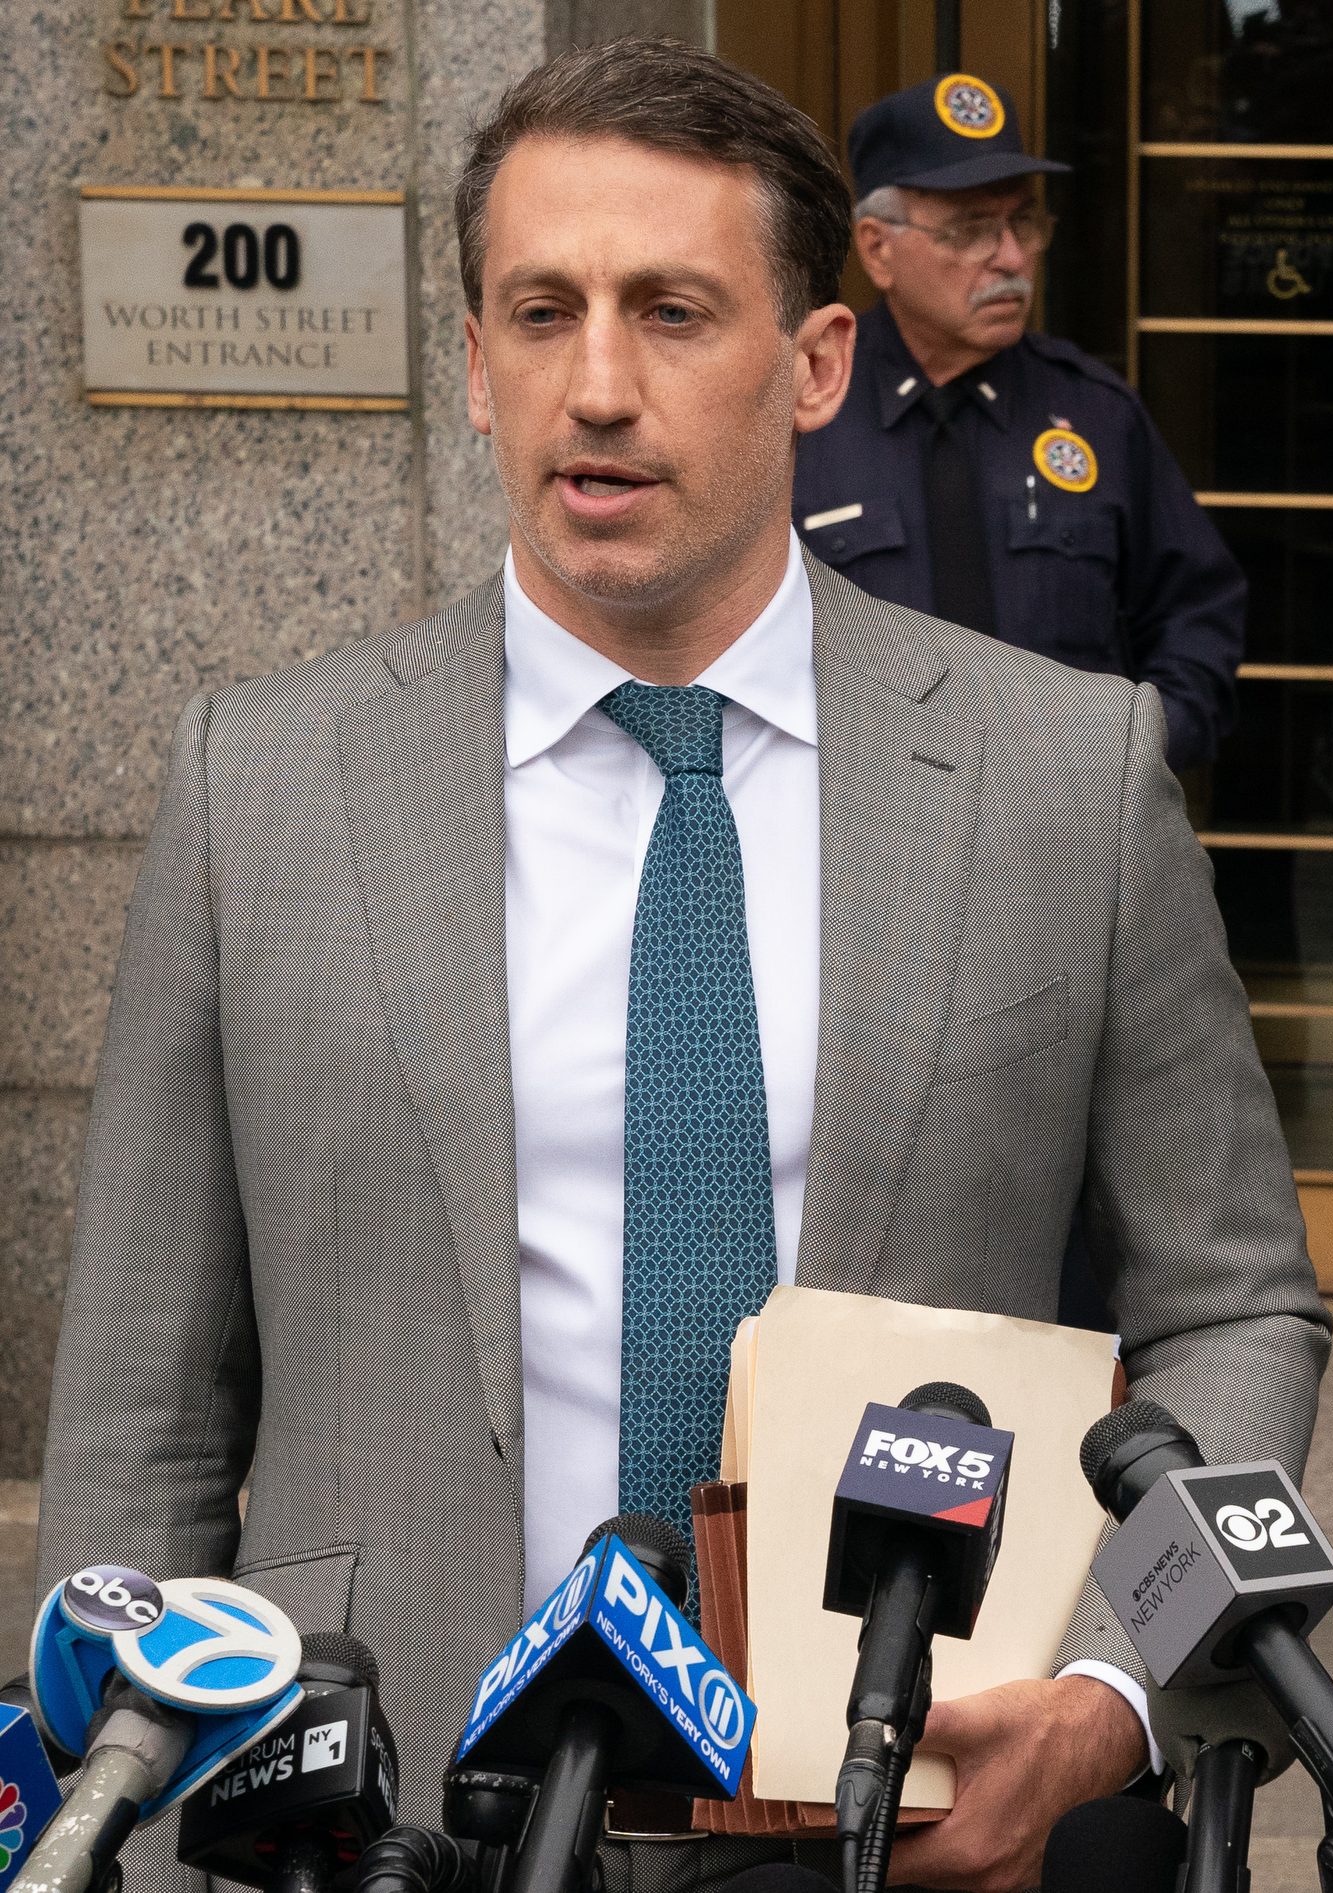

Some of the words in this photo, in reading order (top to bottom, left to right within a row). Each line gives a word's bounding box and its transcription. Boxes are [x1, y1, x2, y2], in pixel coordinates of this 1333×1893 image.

[104, 42, 392, 103] STREET
[182, 222, 301, 291] 200
[104, 303, 240, 331] WORTH
[255, 305, 380, 335] STREET
[147, 341, 338, 369] ENTRANCE
[860, 1456, 911, 1474] NEW
[923, 1469, 985, 1491] YORK
[863, 1429, 961, 1474] FOX
[956, 1449, 995, 1479] 5
[1131, 1585, 1164, 1634] NEW
[1160, 1541, 1202, 1593] YORK
[1138, 1570, 1156, 1594] CBS
[1153, 1541, 1179, 1576] NEWS
[71, 1570, 158, 1624] abc
[604, 1551, 706, 1706] PIX
[463, 1716, 487, 1751] NEW
[552, 1612, 581, 1648] OWN
[471, 1593, 562, 1726] PIX
[597, 1611, 626, 1650] NEW
[626, 1644, 669, 1705] YORK'S
[670, 1697, 702, 1743] VERY
[701, 1739, 731, 1781] OWN
[308, 1728, 332, 1745] NY
[329, 1741, 340, 1760] 1
[211, 1754, 294, 1808] NEWS
